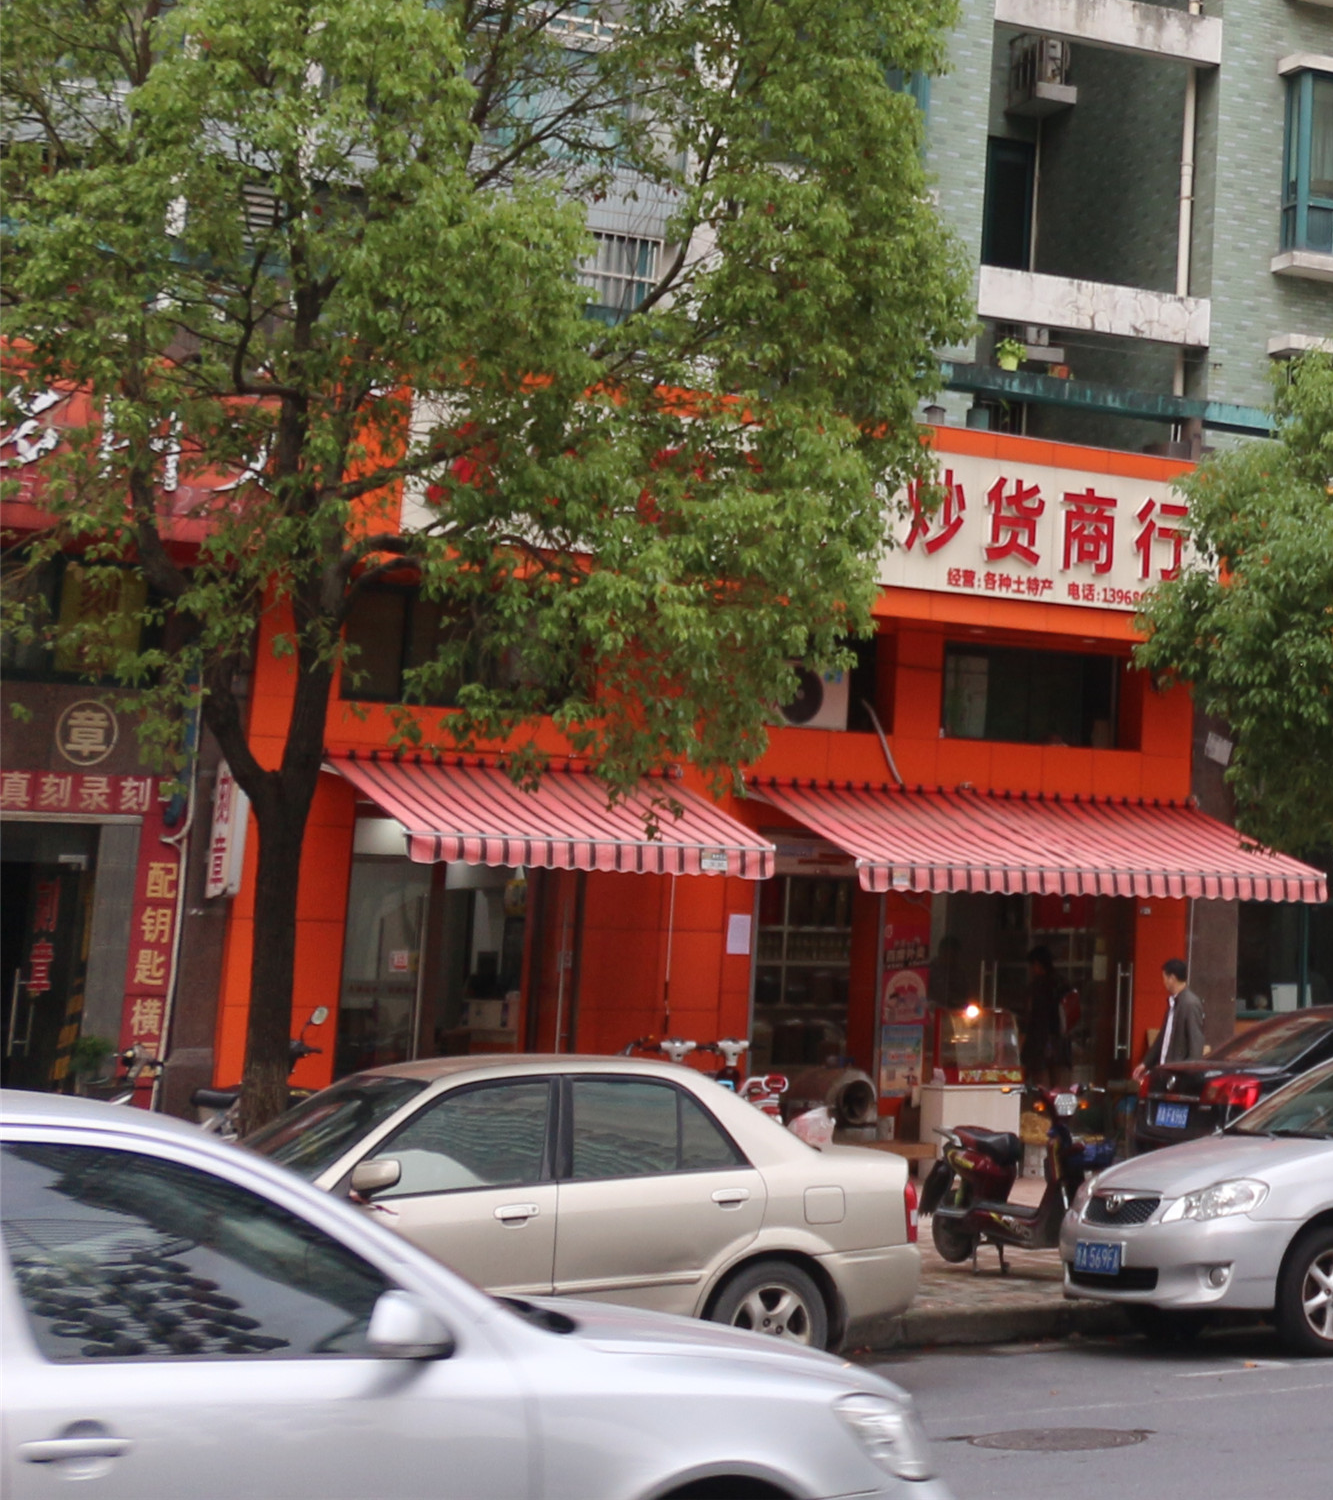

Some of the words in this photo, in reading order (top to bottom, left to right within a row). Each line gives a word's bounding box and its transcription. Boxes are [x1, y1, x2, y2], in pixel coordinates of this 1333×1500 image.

[902, 468, 1190, 582] 炒货商行
[65, 710, 109, 756] 章
[0, 770, 173, 812] 真刻录刻
[133, 861, 178, 986] 配钥匙
